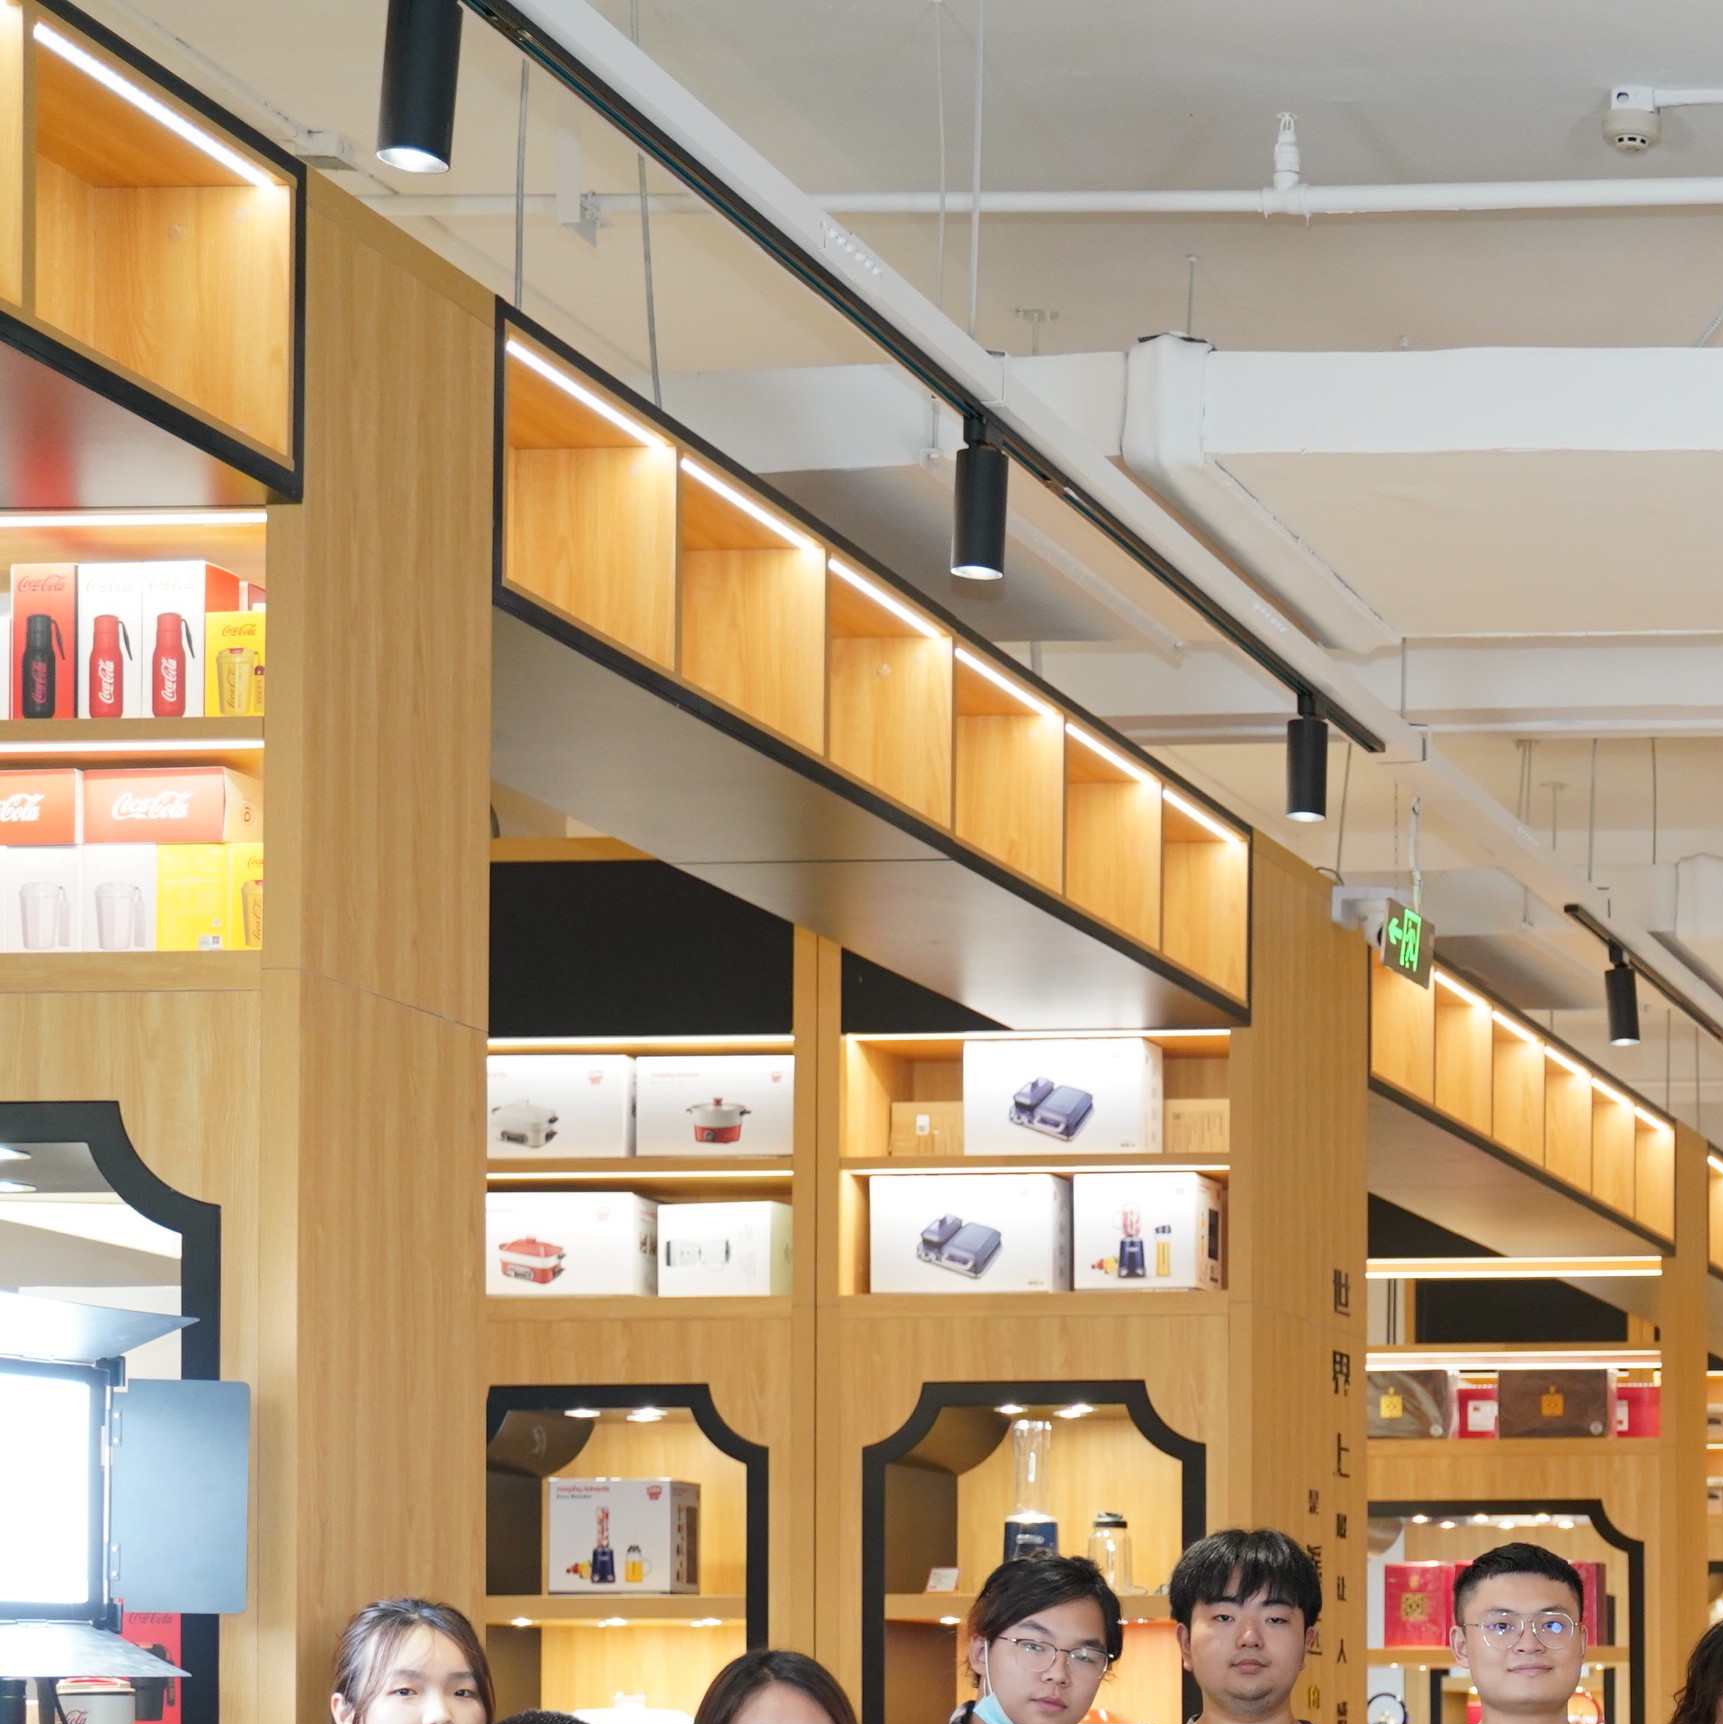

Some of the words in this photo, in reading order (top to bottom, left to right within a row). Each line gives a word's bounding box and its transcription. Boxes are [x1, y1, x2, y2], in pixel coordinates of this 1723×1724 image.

[18, 576, 66, 592] Coca-Cola
[222, 623, 256, 637] Coca-Cola
[98, 657, 115, 704] Coca-Cola
[161, 656, 177, 702] Coca-Cola
[112, 790, 194, 820] Coca-Cola
